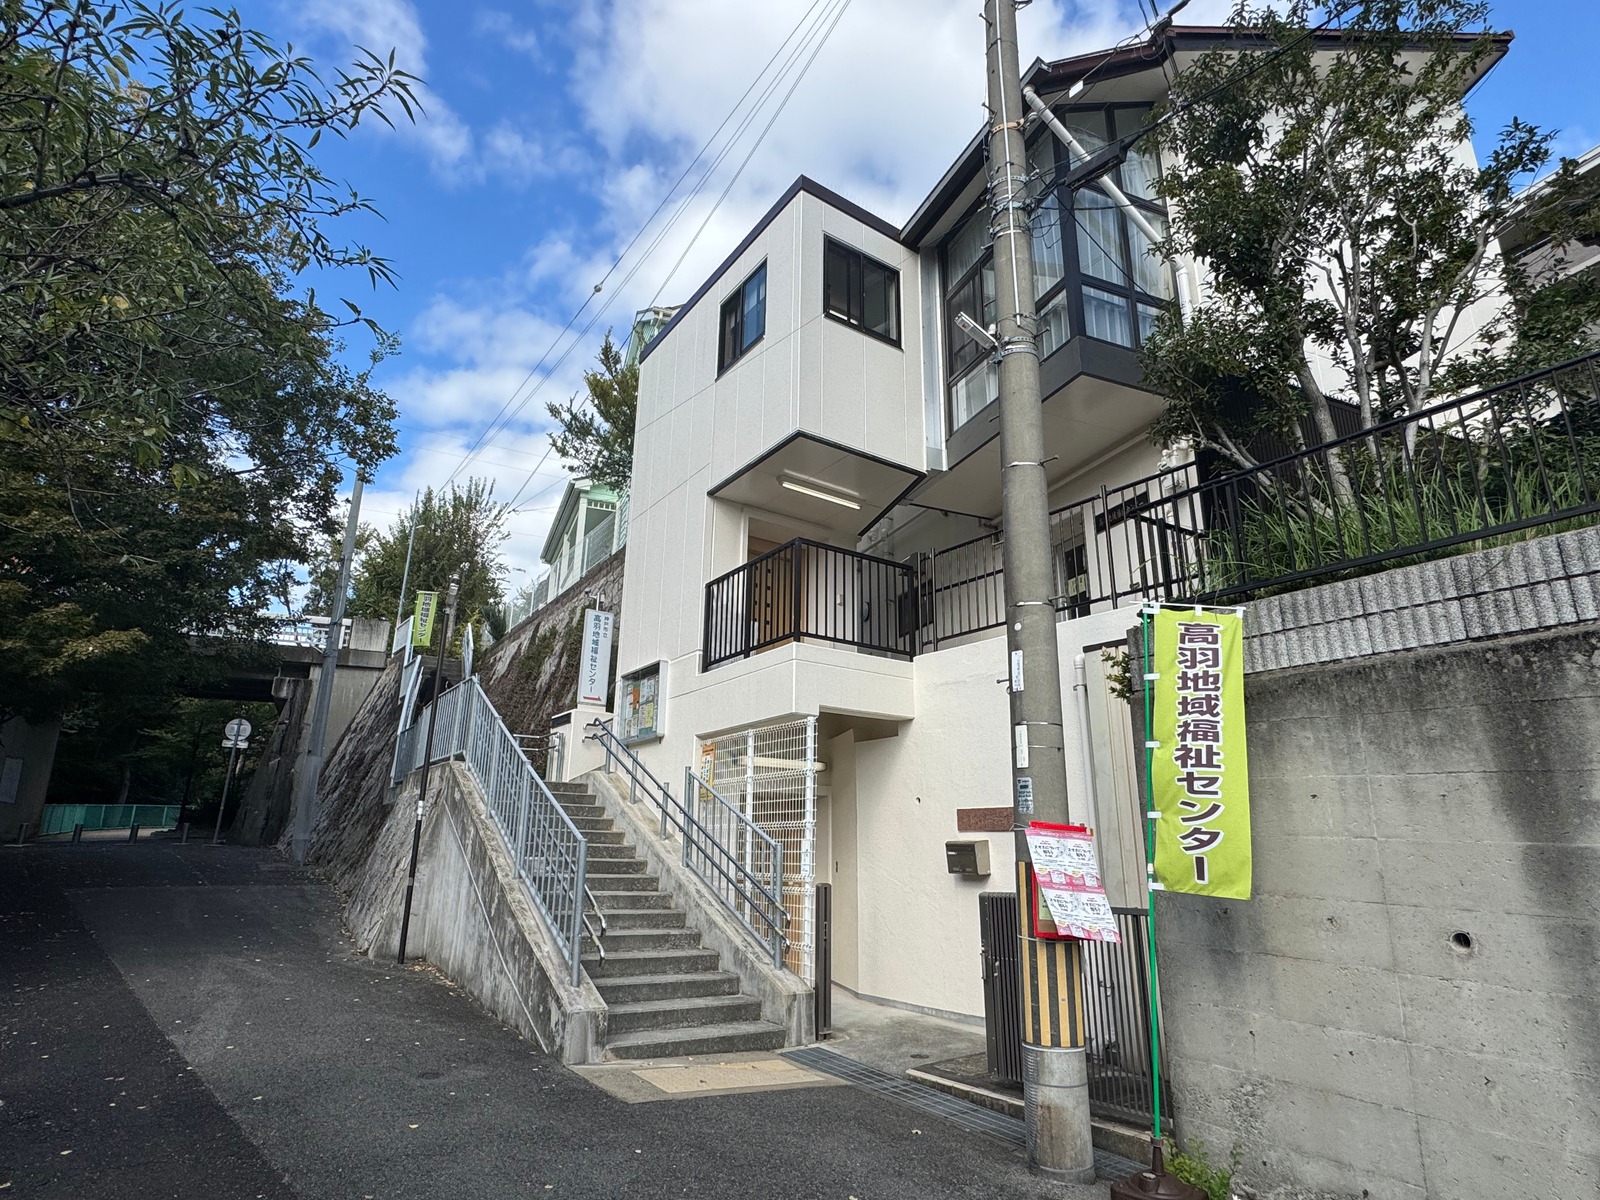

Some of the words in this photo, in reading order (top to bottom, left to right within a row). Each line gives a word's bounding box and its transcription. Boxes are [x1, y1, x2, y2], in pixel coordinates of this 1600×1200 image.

[588, 614, 602, 693] 高羽地域福祉センター
[1174, 622, 1222, 882] 高羽地域福祉センター
